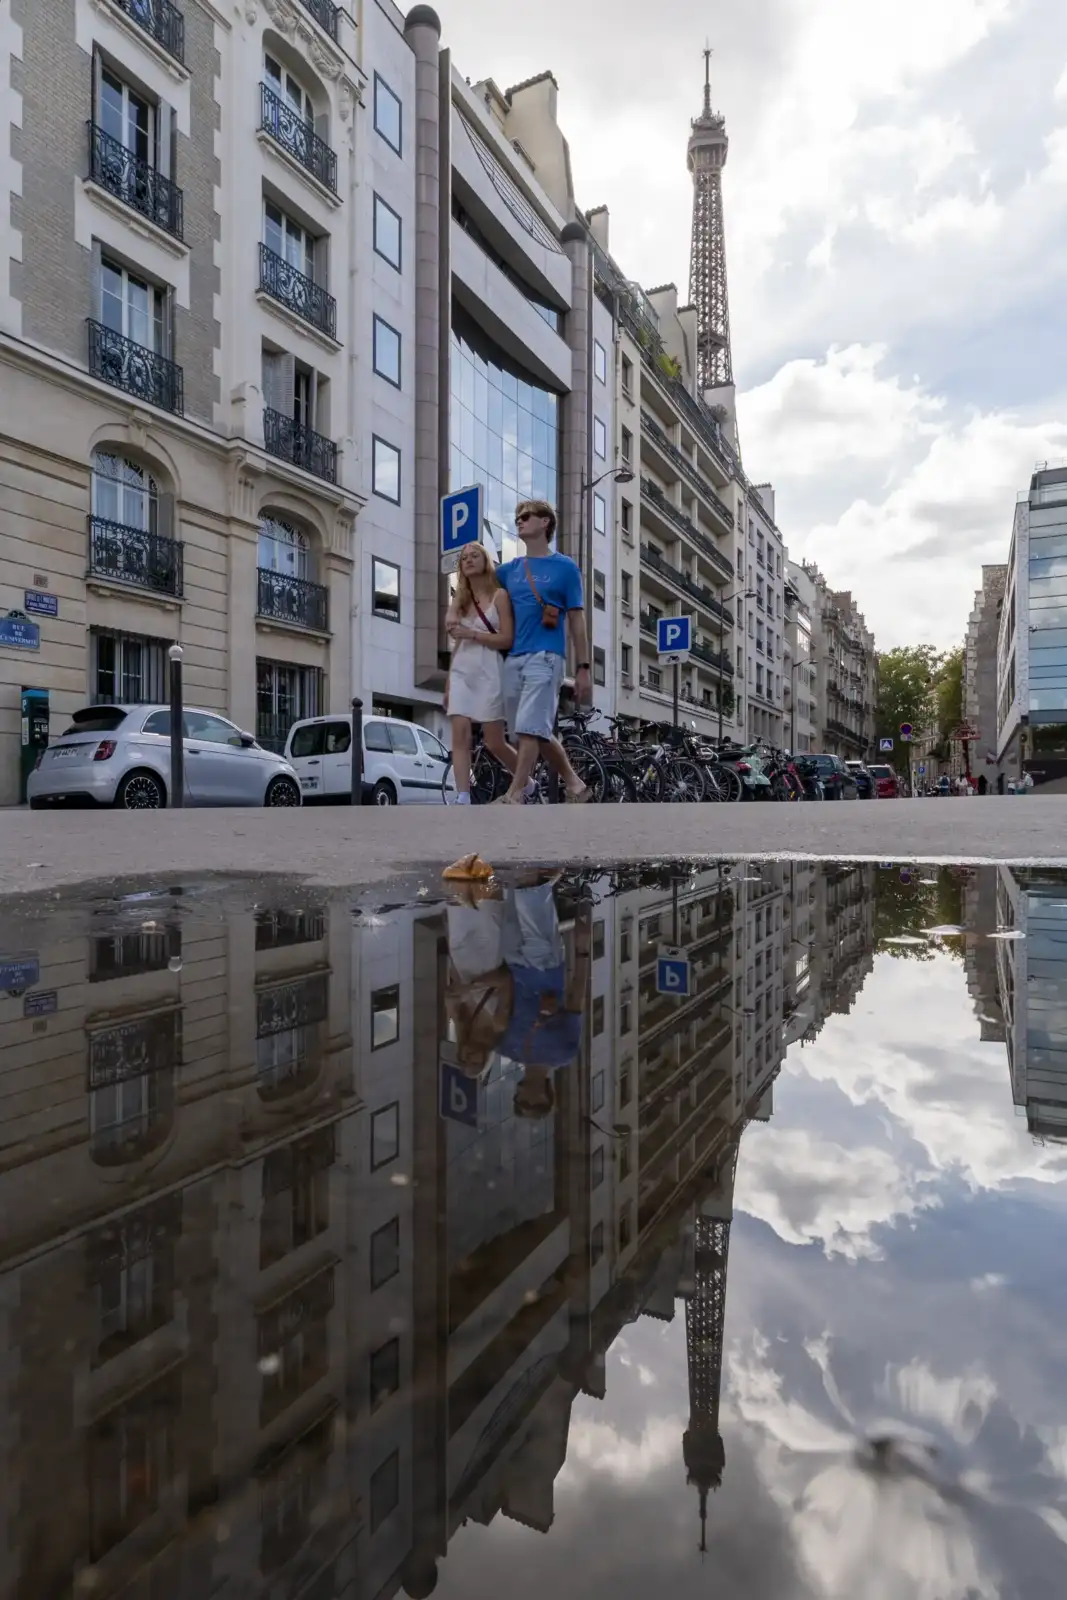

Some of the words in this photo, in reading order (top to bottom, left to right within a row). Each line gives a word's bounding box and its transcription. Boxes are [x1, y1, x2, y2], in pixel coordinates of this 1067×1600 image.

[452, 502, 469, 540] P
[12, 623, 26, 632] RUE
[666, 624, 681, 646] P
